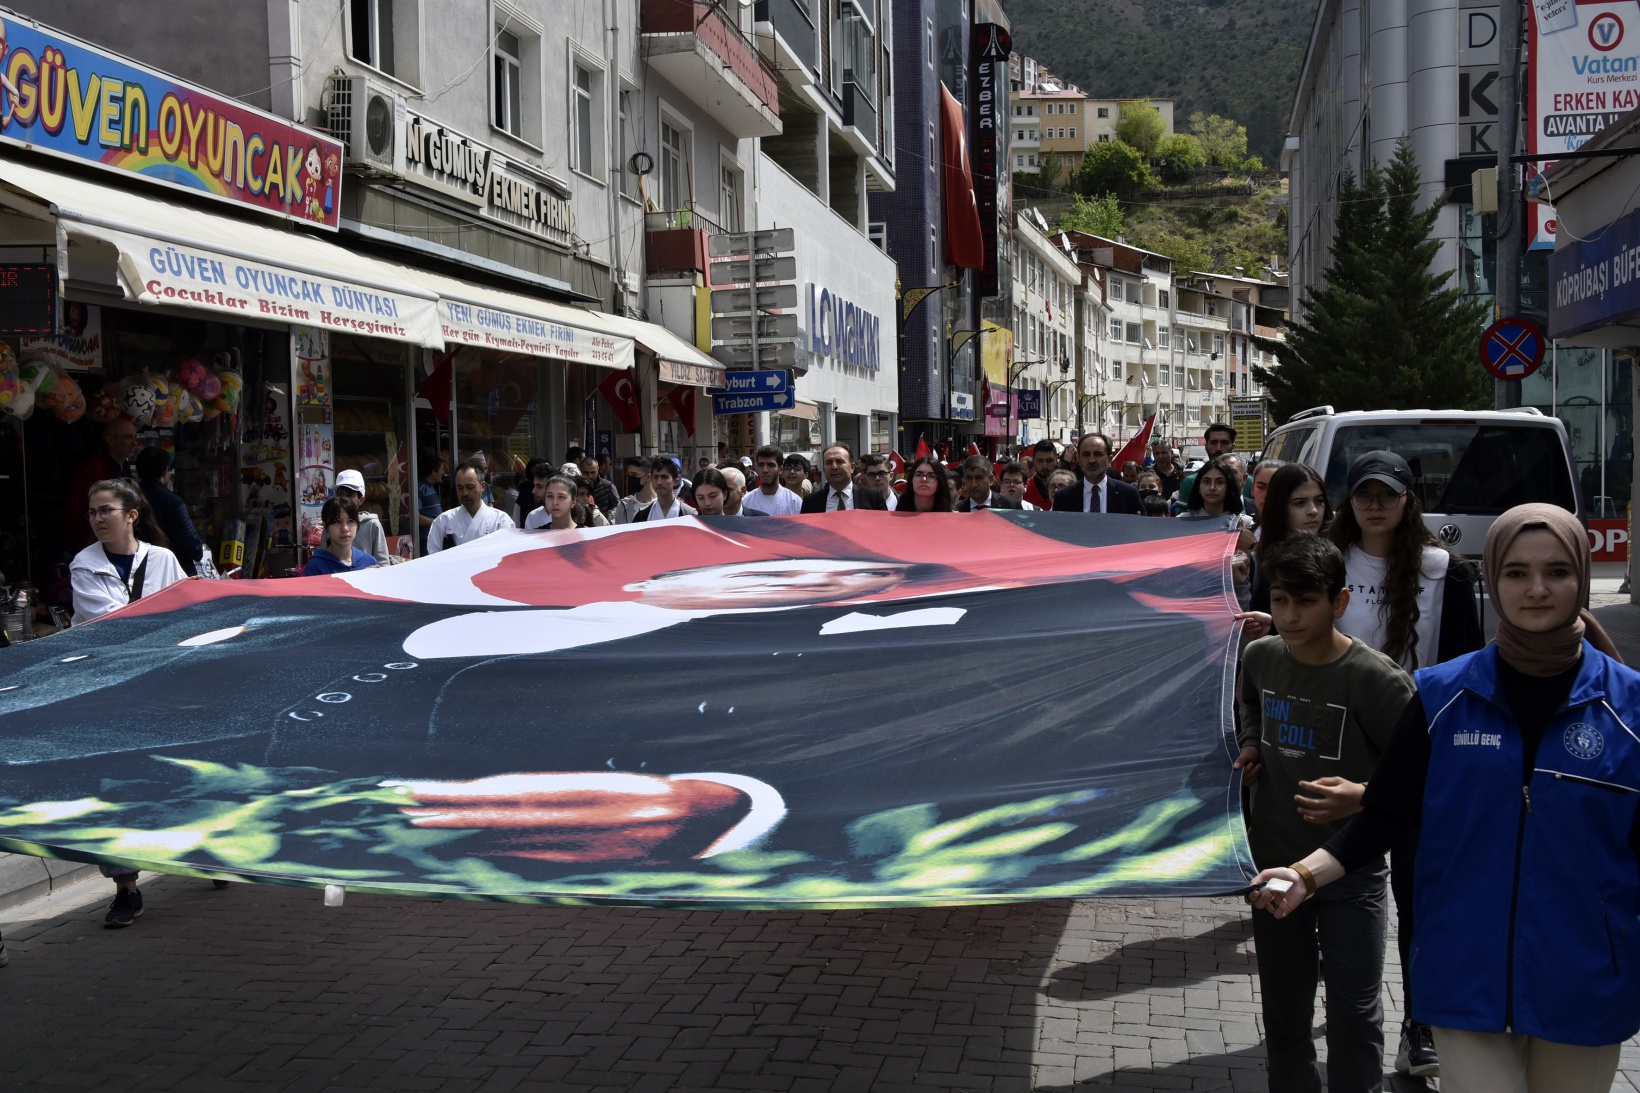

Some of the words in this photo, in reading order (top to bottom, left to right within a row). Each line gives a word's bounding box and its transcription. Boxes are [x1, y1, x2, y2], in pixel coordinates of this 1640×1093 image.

[1572, 55, 1637, 75] Vatan
[1587, 76, 1605, 84] Kurs
[1606, 74, 1637, 83] Merkezi
[978, 62, 993, 129] EZBER
[1554, 92, 1606, 111] ERKEN
[427, 129, 485, 197] GÜMÜŞ
[492, 172, 538, 221] EKMEK
[149, 247, 227, 285] GÜVEN
[236, 265, 325, 304] OYUNCAK
[332, 285, 399, 318] DÜNYASI
[1557, 260, 1609, 308] KÖPRÜBAŞI
[146, 280, 248, 310] Çocuklar
[258, 298, 309, 320] Bizim
[320, 310, 406, 336] Herşeyimiz
[447, 303, 473, 324] YENİ
[477, 308, 512, 333] GÜMÜŞ
[516, 318, 546, 339] EKMEK
[550, 325, 574, 343] FIRINI
[442, 325, 459, 338] Her
[463, 330, 479, 342] gün
[671, 363, 691, 380] YILDIZ
[718, 397, 763, 409] Trabzon
[1018, 399, 1038, 411] kral
[1454, 730, 1480, 746] GÖNÜLLÜ
[1481, 733, 1502, 749] GENÇ
